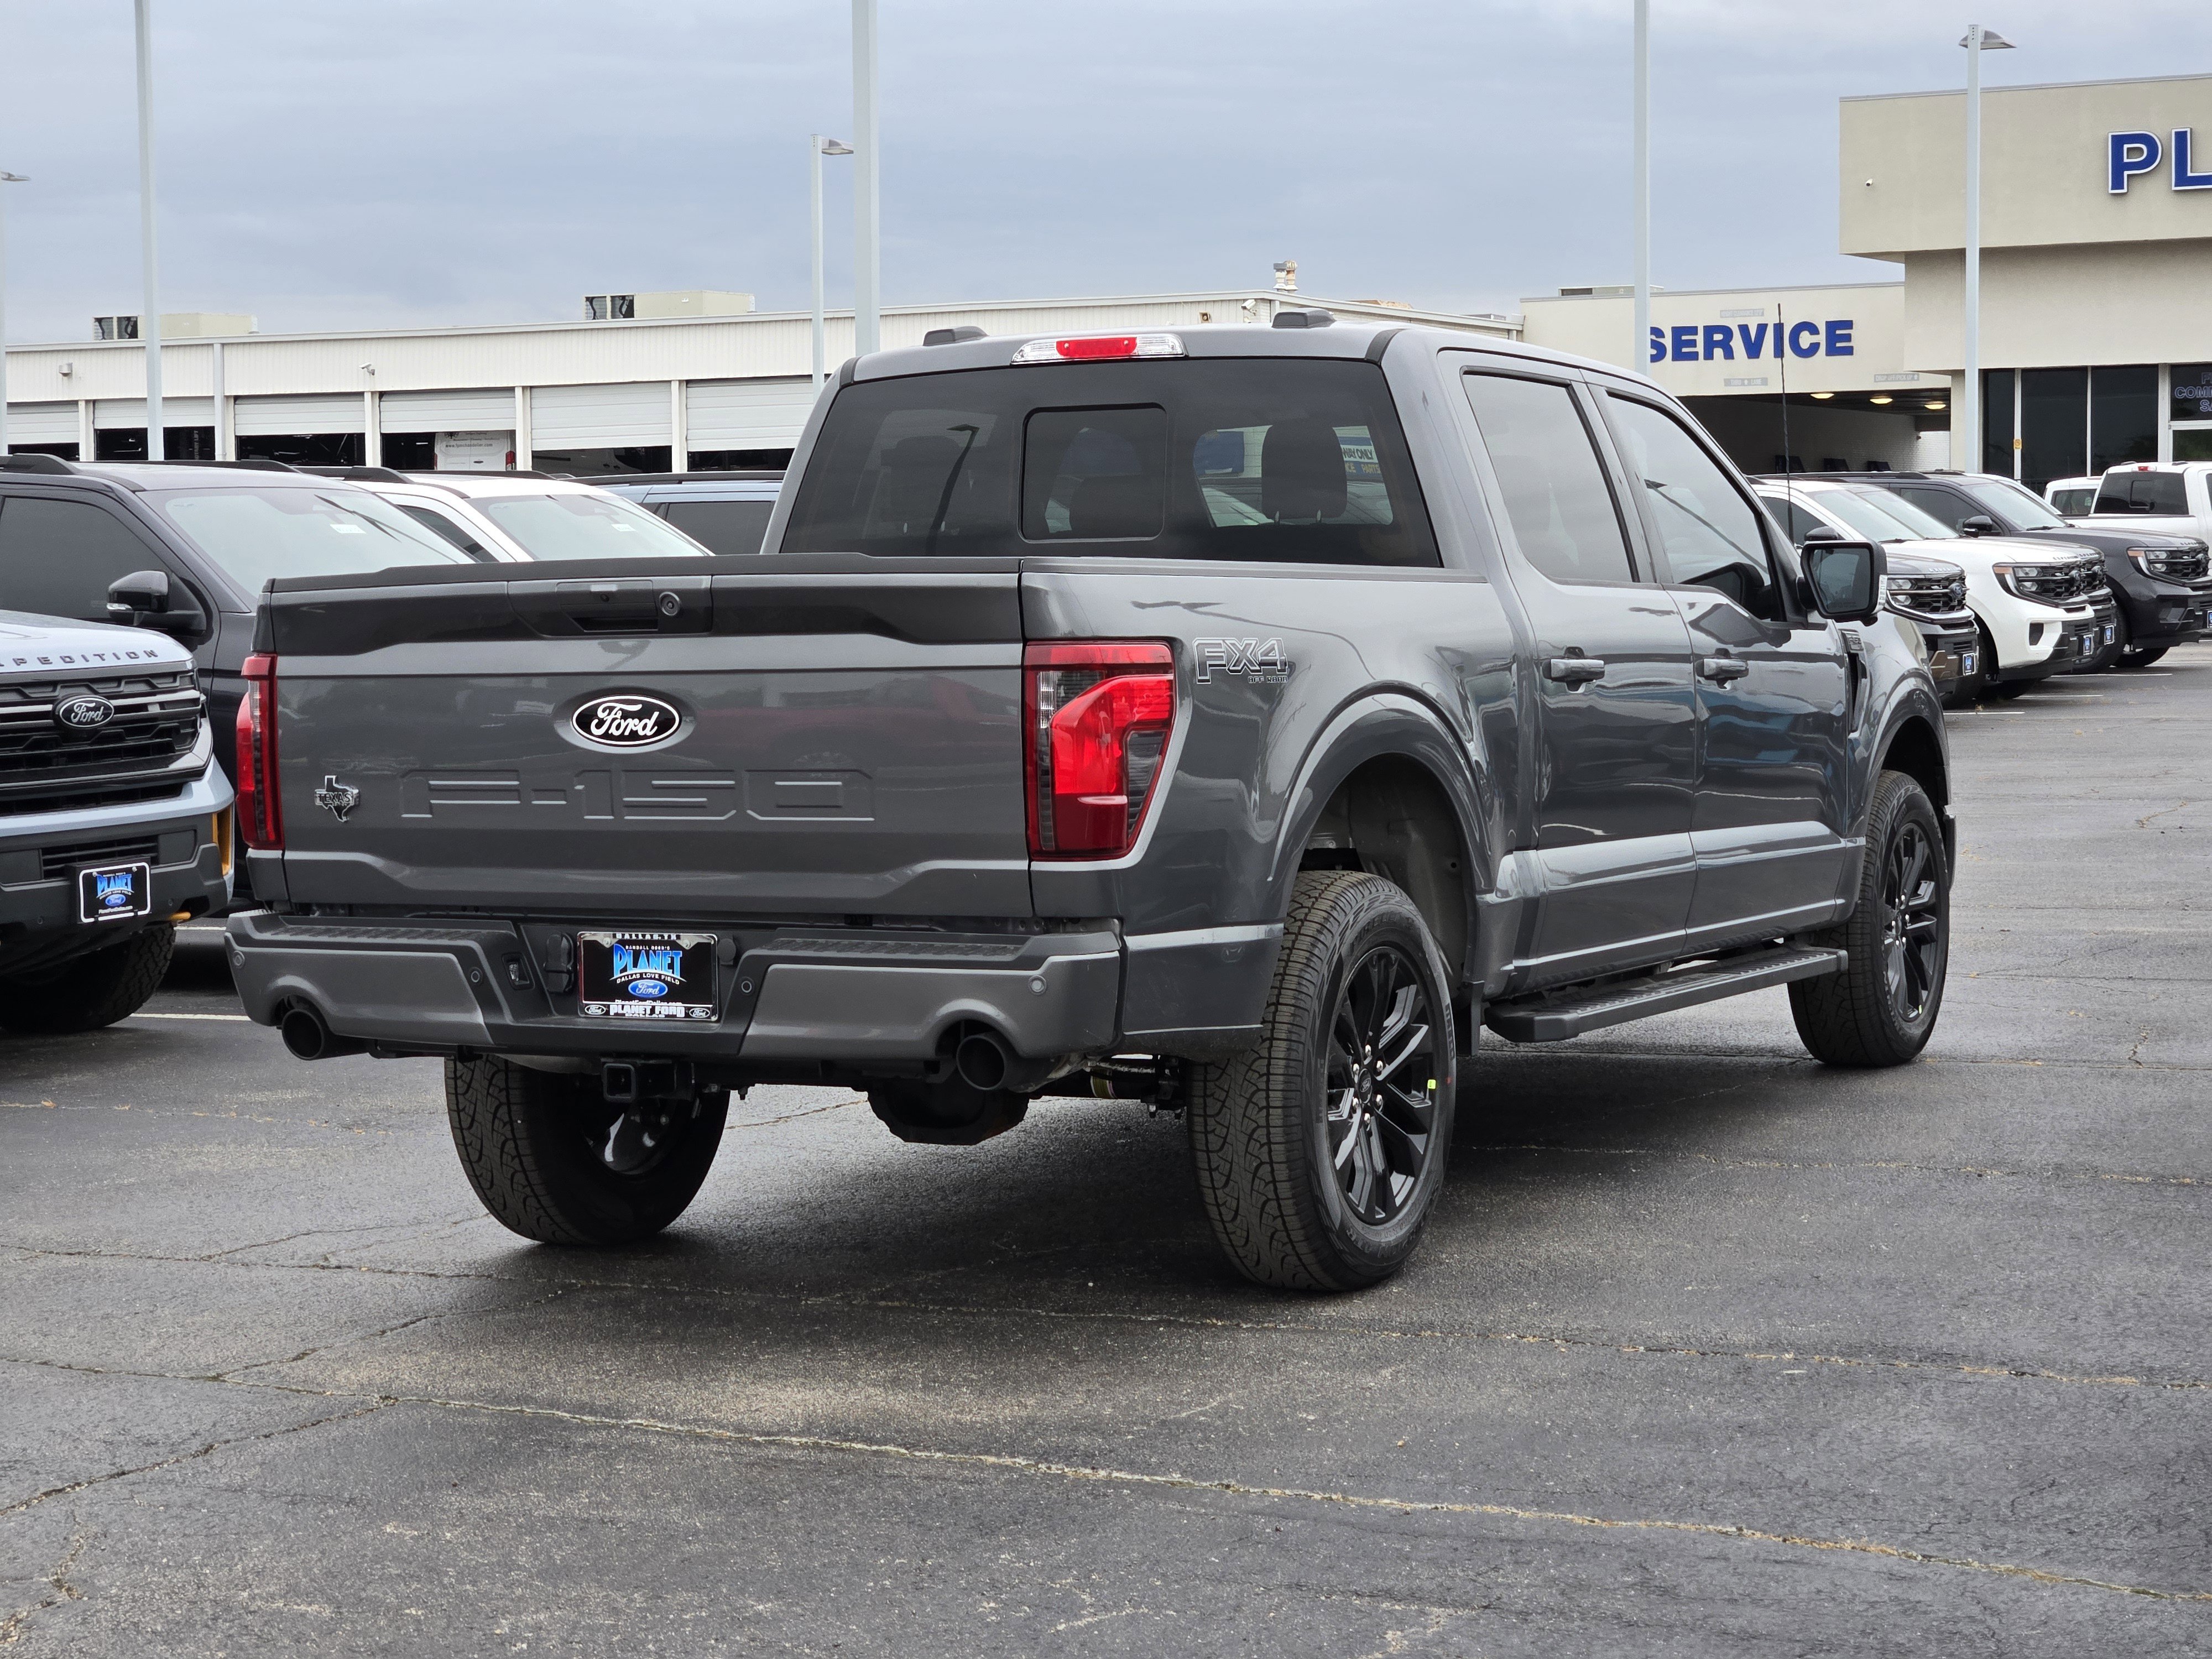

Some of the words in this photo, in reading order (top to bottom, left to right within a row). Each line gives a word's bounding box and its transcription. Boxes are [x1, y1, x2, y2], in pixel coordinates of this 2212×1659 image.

[1650, 320, 1854, 363] SERVICE
[2201, 372, 2212, 384] F
[2199, 399, 2212, 412] S
[1355, 448, 1374, 460] ONLY
[0, 649, 159, 667] PEDITION
[1192, 638, 1288, 684] FX4
[71, 702, 105, 723] Ford
[590, 702, 660, 735] Ford
[315, 792, 352, 804] TEXAS
[400, 769, 875, 821] F-150
[96, 873, 132, 897] PLANET
[614, 943, 682, 978] PLANET
[617, 974, 640, 984] DALLAS
[661, 975, 680, 985] FIELD
[636, 982, 659, 995] Ford
[609, 1004, 652, 1016] PLANET
[655, 1005, 685, 1018] FORD
[693, 1009, 707, 1017] Ford
